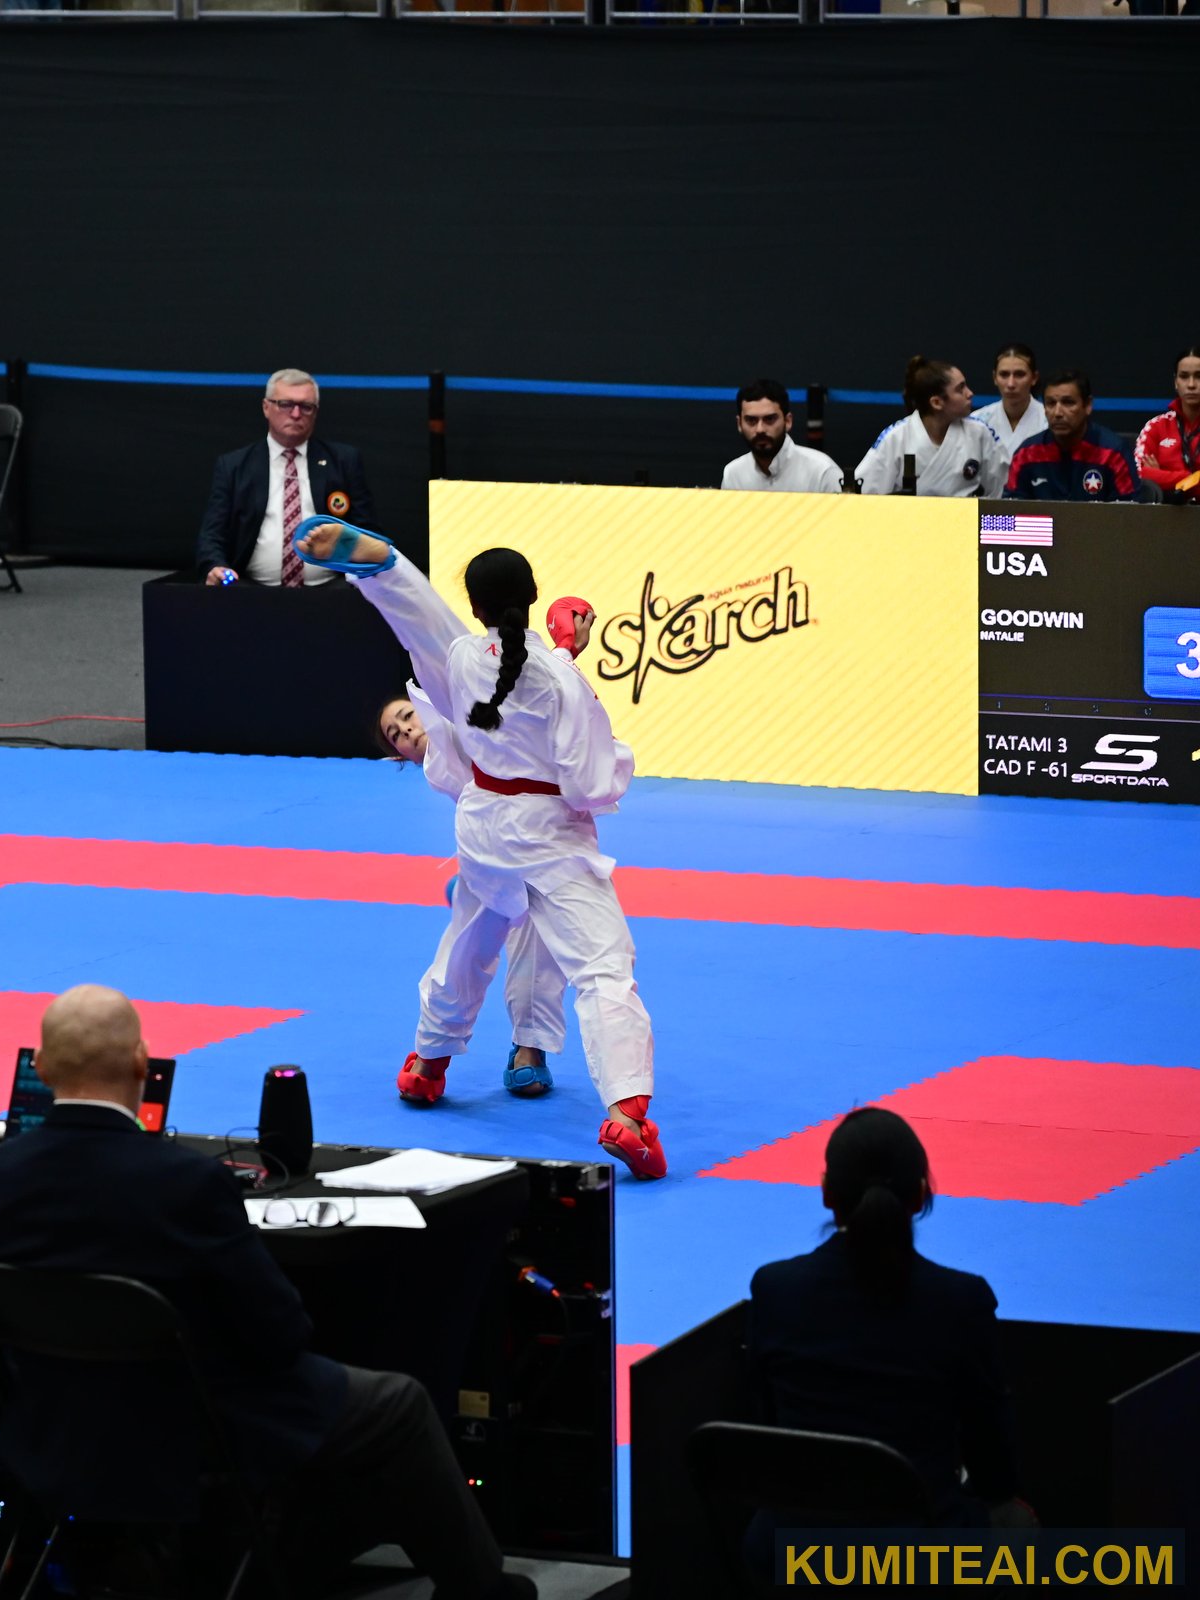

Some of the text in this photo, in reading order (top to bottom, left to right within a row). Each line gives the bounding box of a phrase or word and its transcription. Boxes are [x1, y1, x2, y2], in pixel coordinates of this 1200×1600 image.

[986, 551, 1048, 577] USA
[707, 573, 772, 601] agua natural
[981, 608, 1084, 629] GOODWIN
[980, 630, 1025, 643] NATALIE
[1176, 631, 1200, 679] 3
[986, 734, 1068, 753] TATAMI 3
[984, 758, 1068, 778] CAD F -61
[1071, 773, 1170, 788] SPORTDATA
